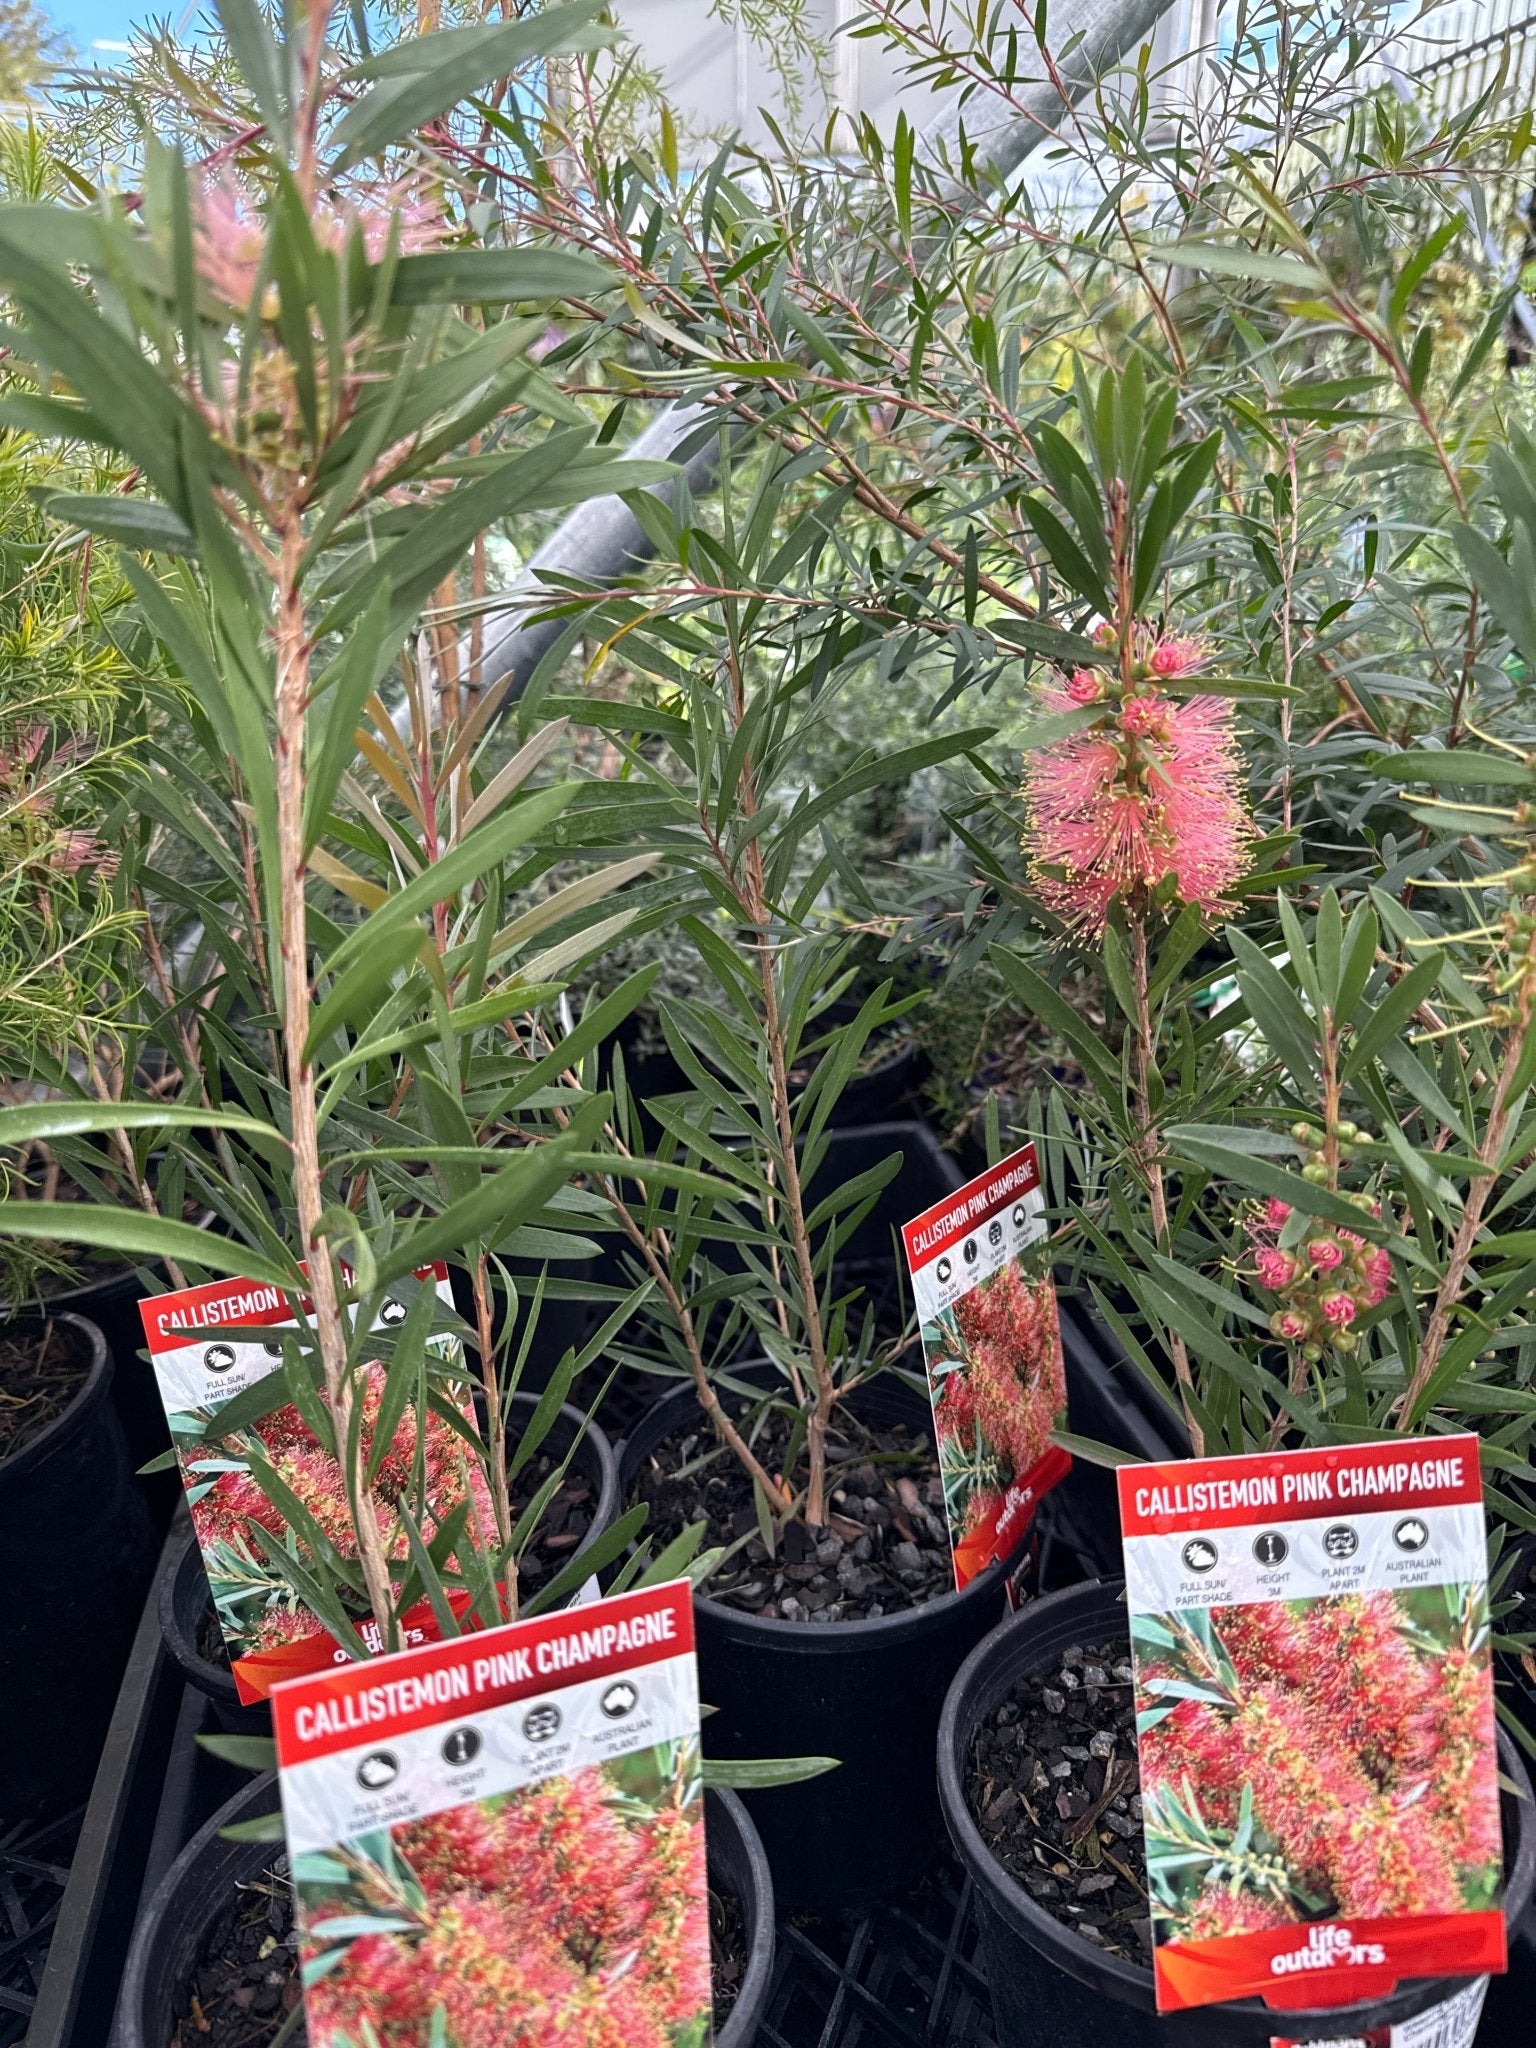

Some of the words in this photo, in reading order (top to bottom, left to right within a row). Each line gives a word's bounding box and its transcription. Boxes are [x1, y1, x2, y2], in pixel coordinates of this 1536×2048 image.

[912, 1204, 969, 1256] CALLISTEMON
[968, 1189, 989, 1218] PINK
[987, 1160, 1035, 1204] CHAMPAGNE
[157, 1286, 280, 1337] CALLISTEMON
[206, 1378, 227, 1390] FULL
[204, 1389, 226, 1402] PART
[1135, 1476, 1278, 1518] CALLISTEMON
[1283, 1470, 1333, 1503] PINK
[1337, 1457, 1464, 1499] CHAMPAGNE
[1321, 1567, 1350, 1578] PLANT
[1352, 1565, 1366, 1576] 2M
[1385, 1557, 1442, 1572] AUSTRALIAN
[1256, 1572, 1291, 1584] HEIGHT
[1329, 1578, 1360, 1590] APART
[1400, 1572, 1429, 1583] PLANT
[1180, 1581, 1201, 1593] FULL
[1267, 1587, 1281, 1598] 3M
[1175, 1594, 1200, 1606] PART
[1202, 1591, 1233, 1603] SHADE
[294, 1663, 470, 1743] CALLISTEMON
[474, 1647, 533, 1694] PINK
[536, 1608, 677, 1676] CHAMPAGNE
[592, 1719, 653, 1743] AUSTRALIAN
[608, 1735, 640, 1753] PLANT
[1308, 1924, 1353, 1949] life
